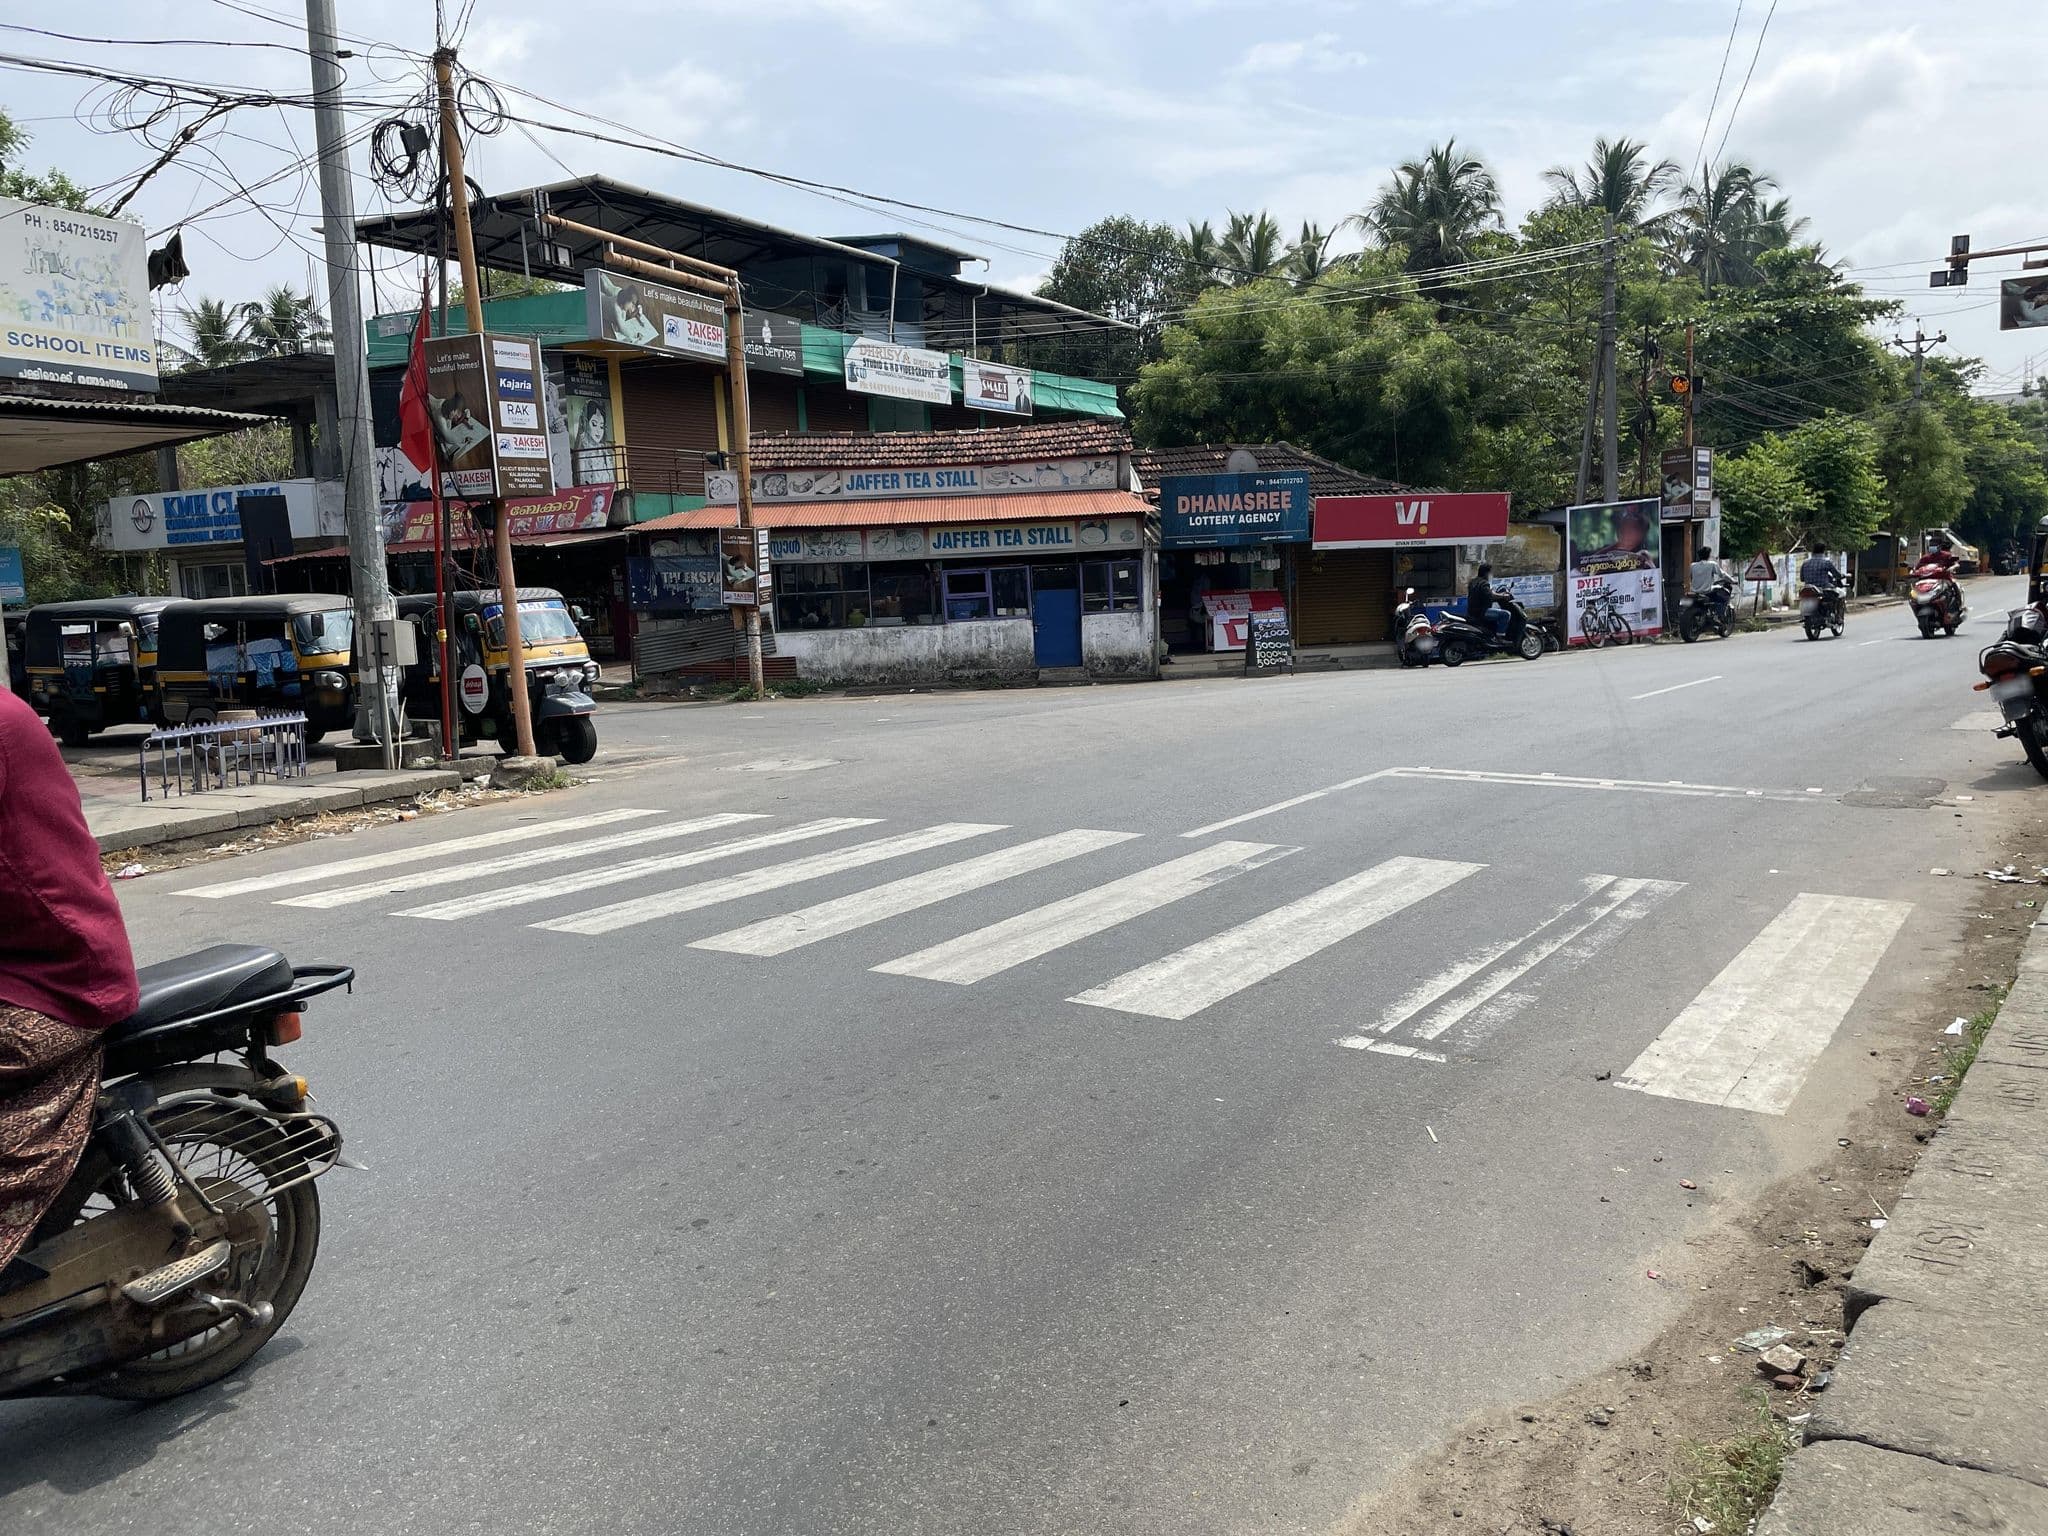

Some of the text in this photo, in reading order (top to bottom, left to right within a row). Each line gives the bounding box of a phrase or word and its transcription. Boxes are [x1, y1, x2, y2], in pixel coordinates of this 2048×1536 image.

[24, 213, 42, 229] PH
[53, 219, 118, 243] 8547215257
[643, 286, 659, 300] Let's
[7, 331, 151, 364] SCHOOL ITEMS
[436, 351, 471, 364] Let's make
[499, 377, 532, 392] Kajaria
[507, 403, 529, 416] RAK
[513, 436, 545, 448] RAKESH
[846, 470, 978, 491] JAFFER TEA STALL
[162, 493, 209, 518] KMH
[1177, 490, 1293, 514] DHANASREE
[1189, 512, 1281, 527] LOTTERY AGENCY
[932, 527, 1073, 550] JAFFER TEA STALL
[1577, 577, 1603, 590] DYFI
